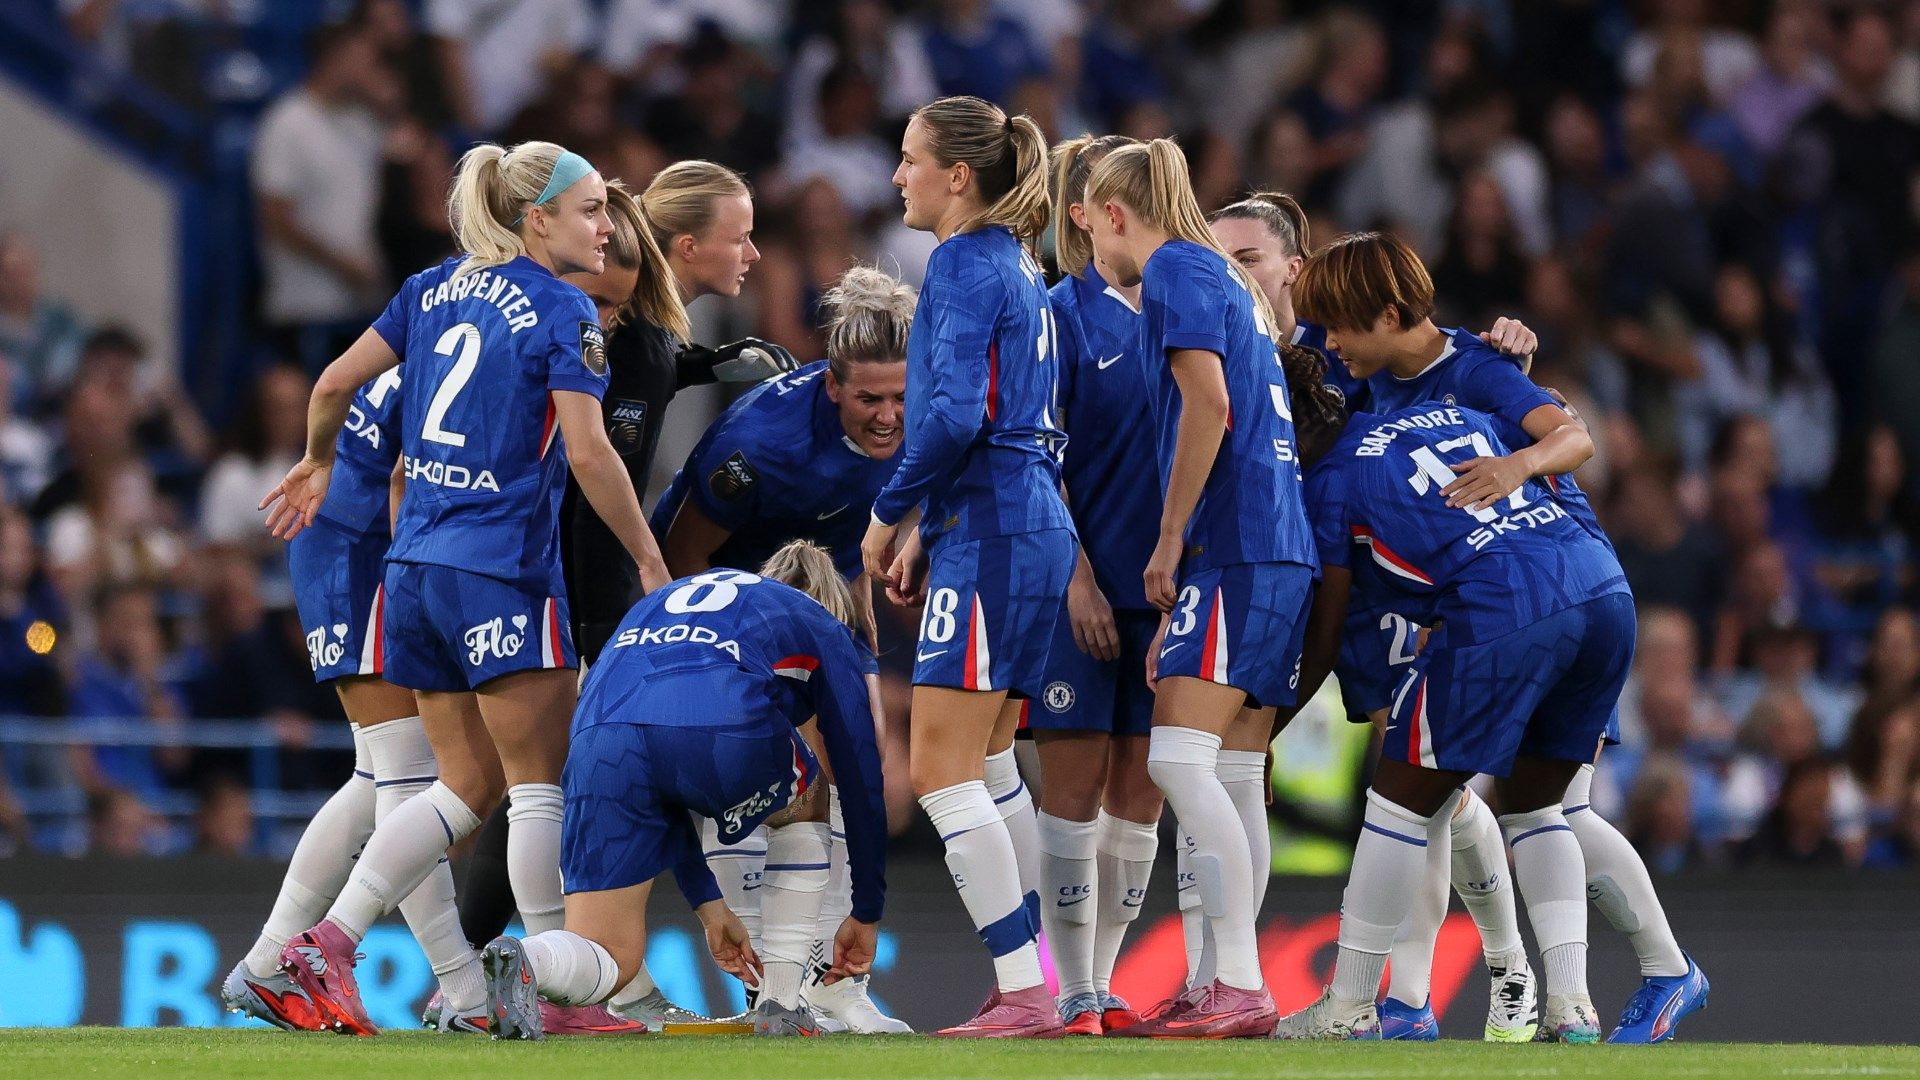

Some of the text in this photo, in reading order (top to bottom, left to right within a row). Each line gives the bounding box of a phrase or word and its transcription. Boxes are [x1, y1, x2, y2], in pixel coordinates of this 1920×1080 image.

[421, 271, 538, 334] CARPENTER
[421, 322, 481, 447] 2
[664, 571, 762, 614] 8
[918, 586, 959, 643] 18
[1165, 585, 1201, 638] 3
[305, 624, 345, 672] Flo
[464, 616, 525, 666] Flo
[614, 624, 741, 662] SKODA
[1391, 667, 1419, 720] 7
[743, 872, 763, 882] CF
[1059, 884, 1091, 897] CFC
[1177, 872, 1196, 883] FC
